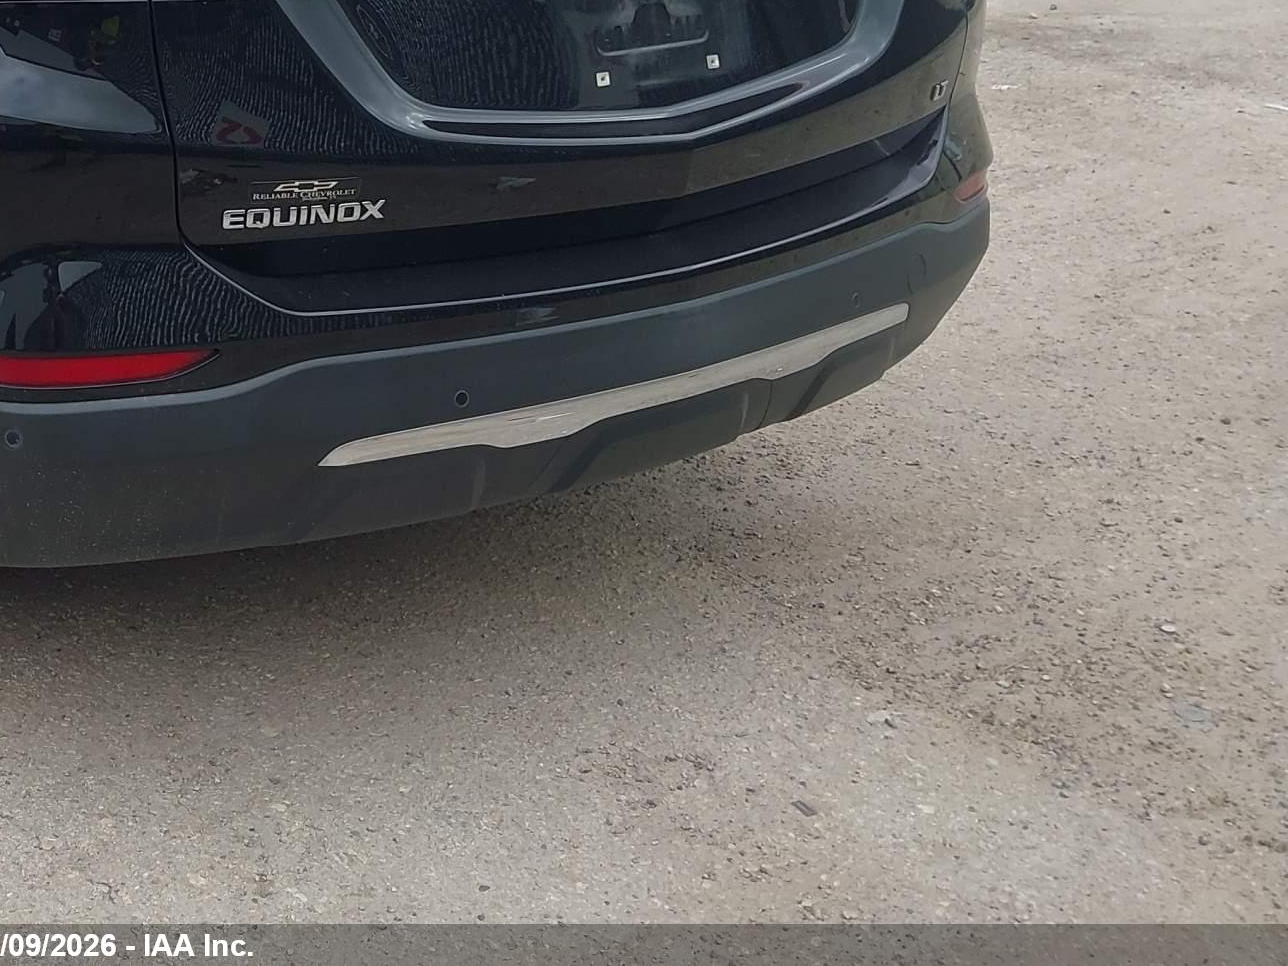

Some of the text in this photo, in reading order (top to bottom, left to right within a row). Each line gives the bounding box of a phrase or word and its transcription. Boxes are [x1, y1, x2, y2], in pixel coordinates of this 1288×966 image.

[252, 192, 298, 200] RELIABLE
[299, 188, 357, 198] CHEVROLET
[222, 199, 386, 229] EQUINOX
